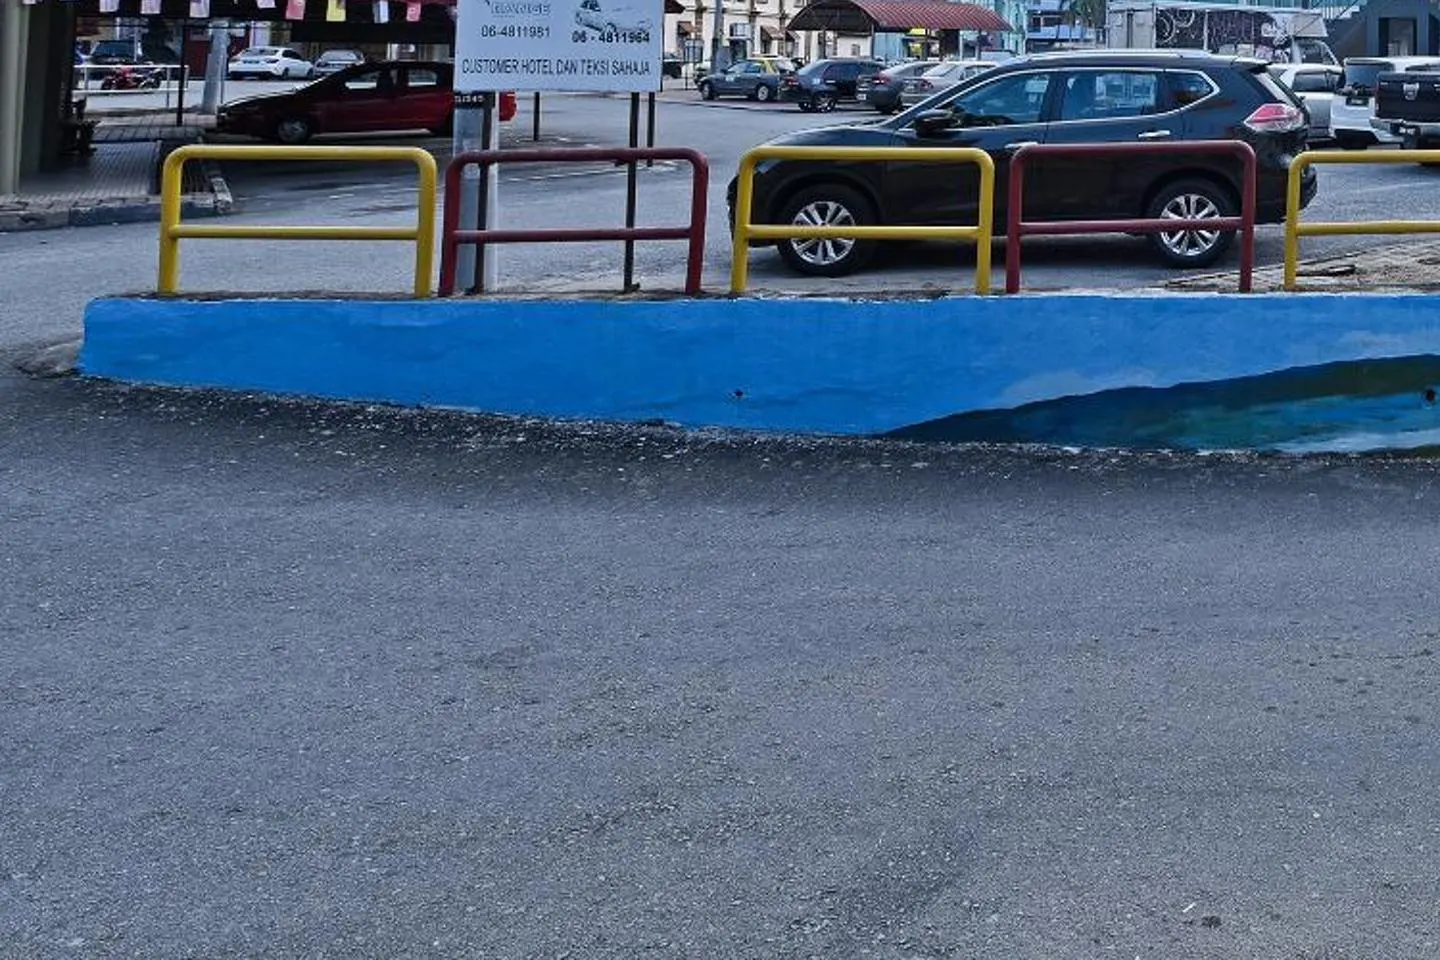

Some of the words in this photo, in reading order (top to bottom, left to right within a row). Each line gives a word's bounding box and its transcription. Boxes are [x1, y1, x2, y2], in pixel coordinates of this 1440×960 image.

[462, 58, 520, 74] CUSTOMER
[522, 59, 555, 74] HOTEL
[556, 60, 578, 74] DAN
[580, 60, 609, 75] TEKSI
[612, 60, 650, 76] SAHAJA
